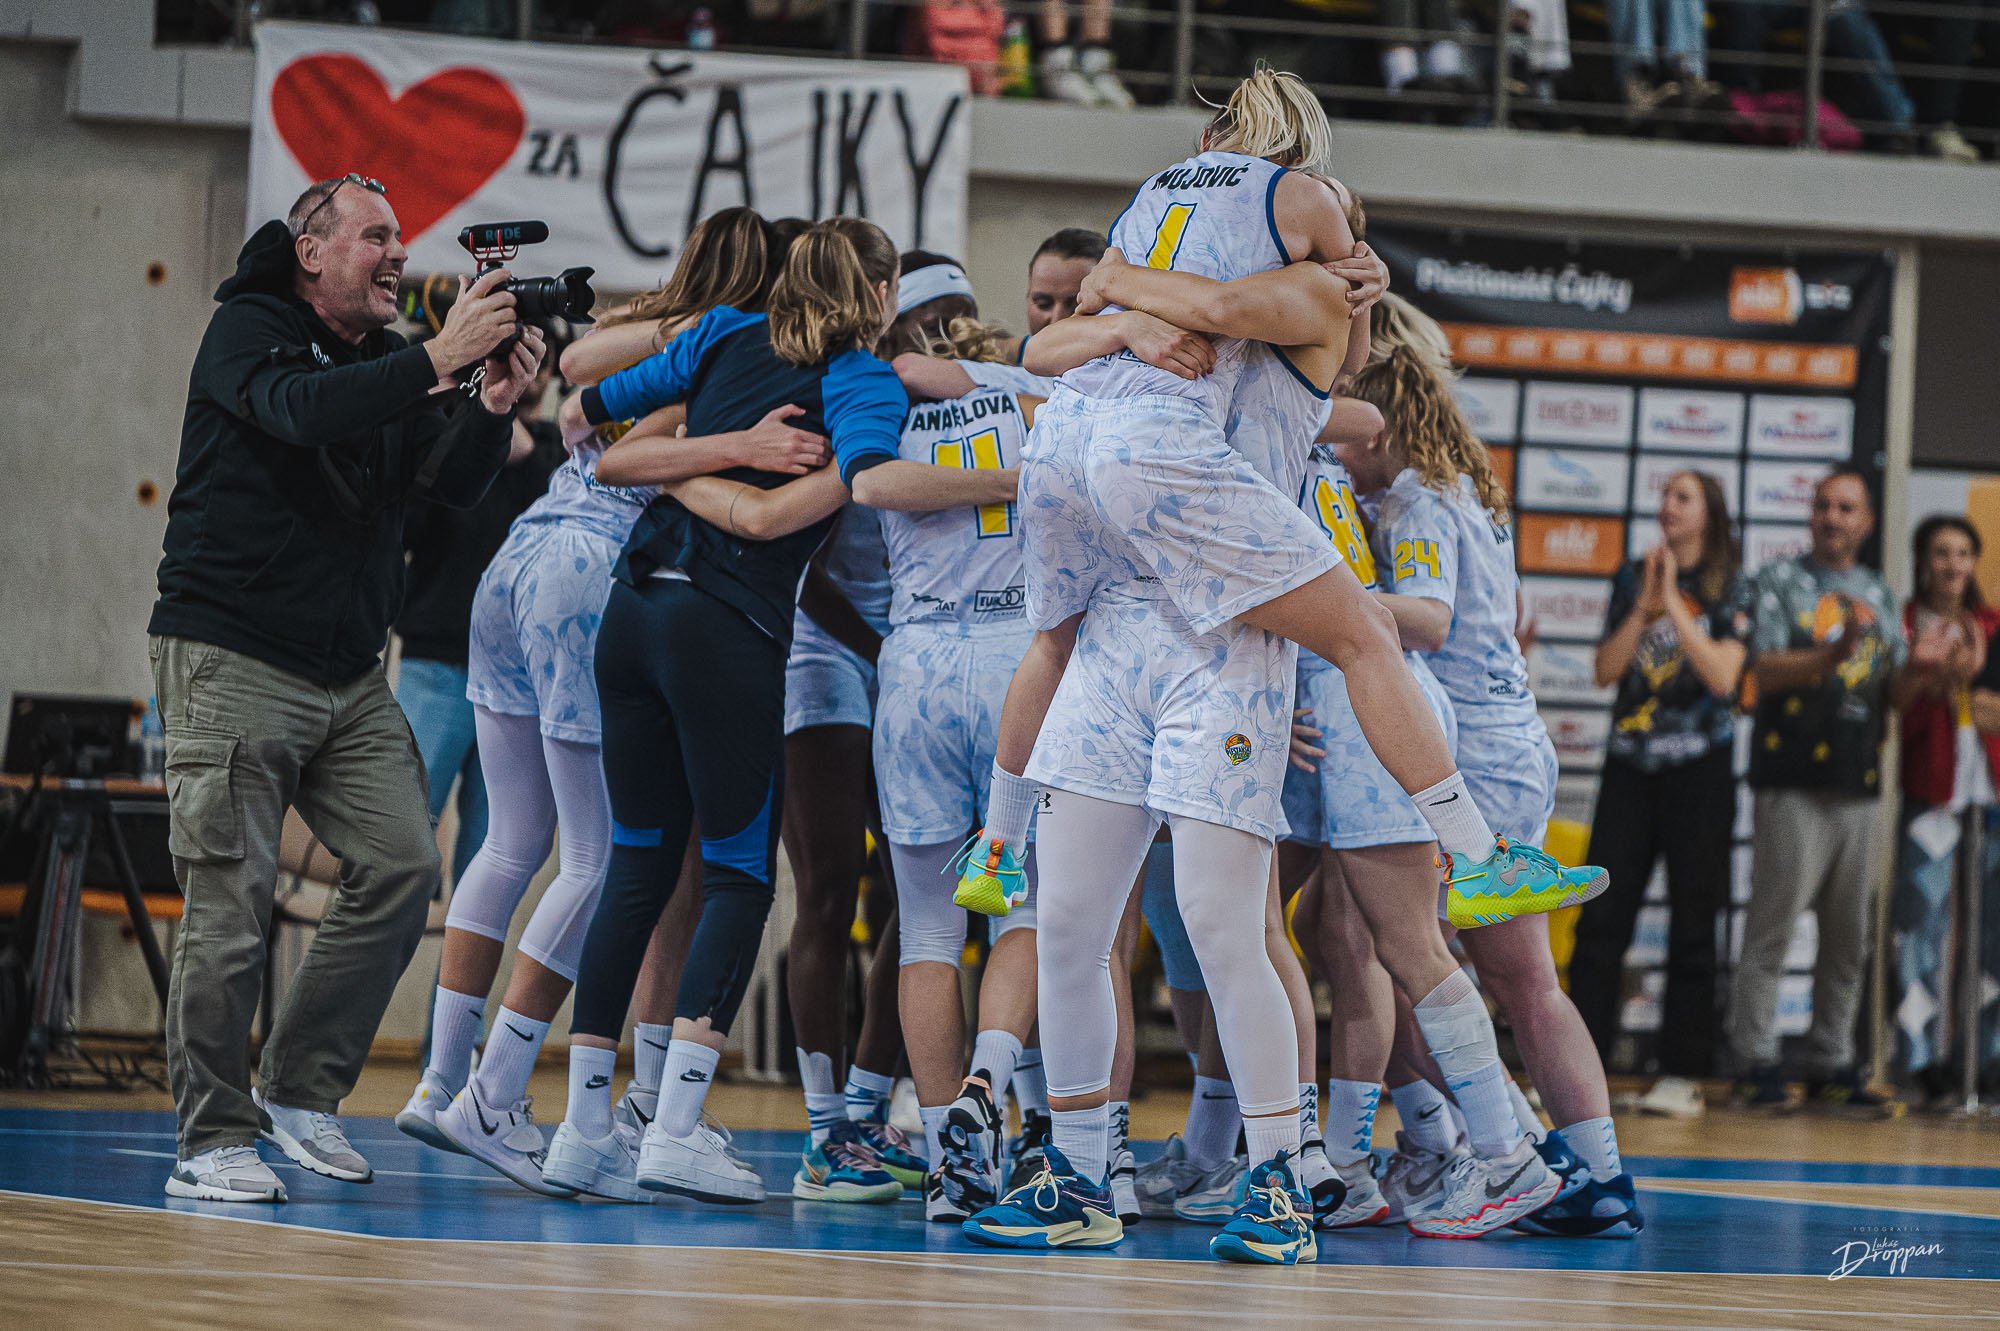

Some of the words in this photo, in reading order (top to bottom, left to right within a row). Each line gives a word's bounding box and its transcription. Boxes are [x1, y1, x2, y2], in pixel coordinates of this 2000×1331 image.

[527, 130, 581, 177] ZA
[1151, 162, 1251, 191] MUJOVIĆ
[1393, 537, 1442, 583] 24
